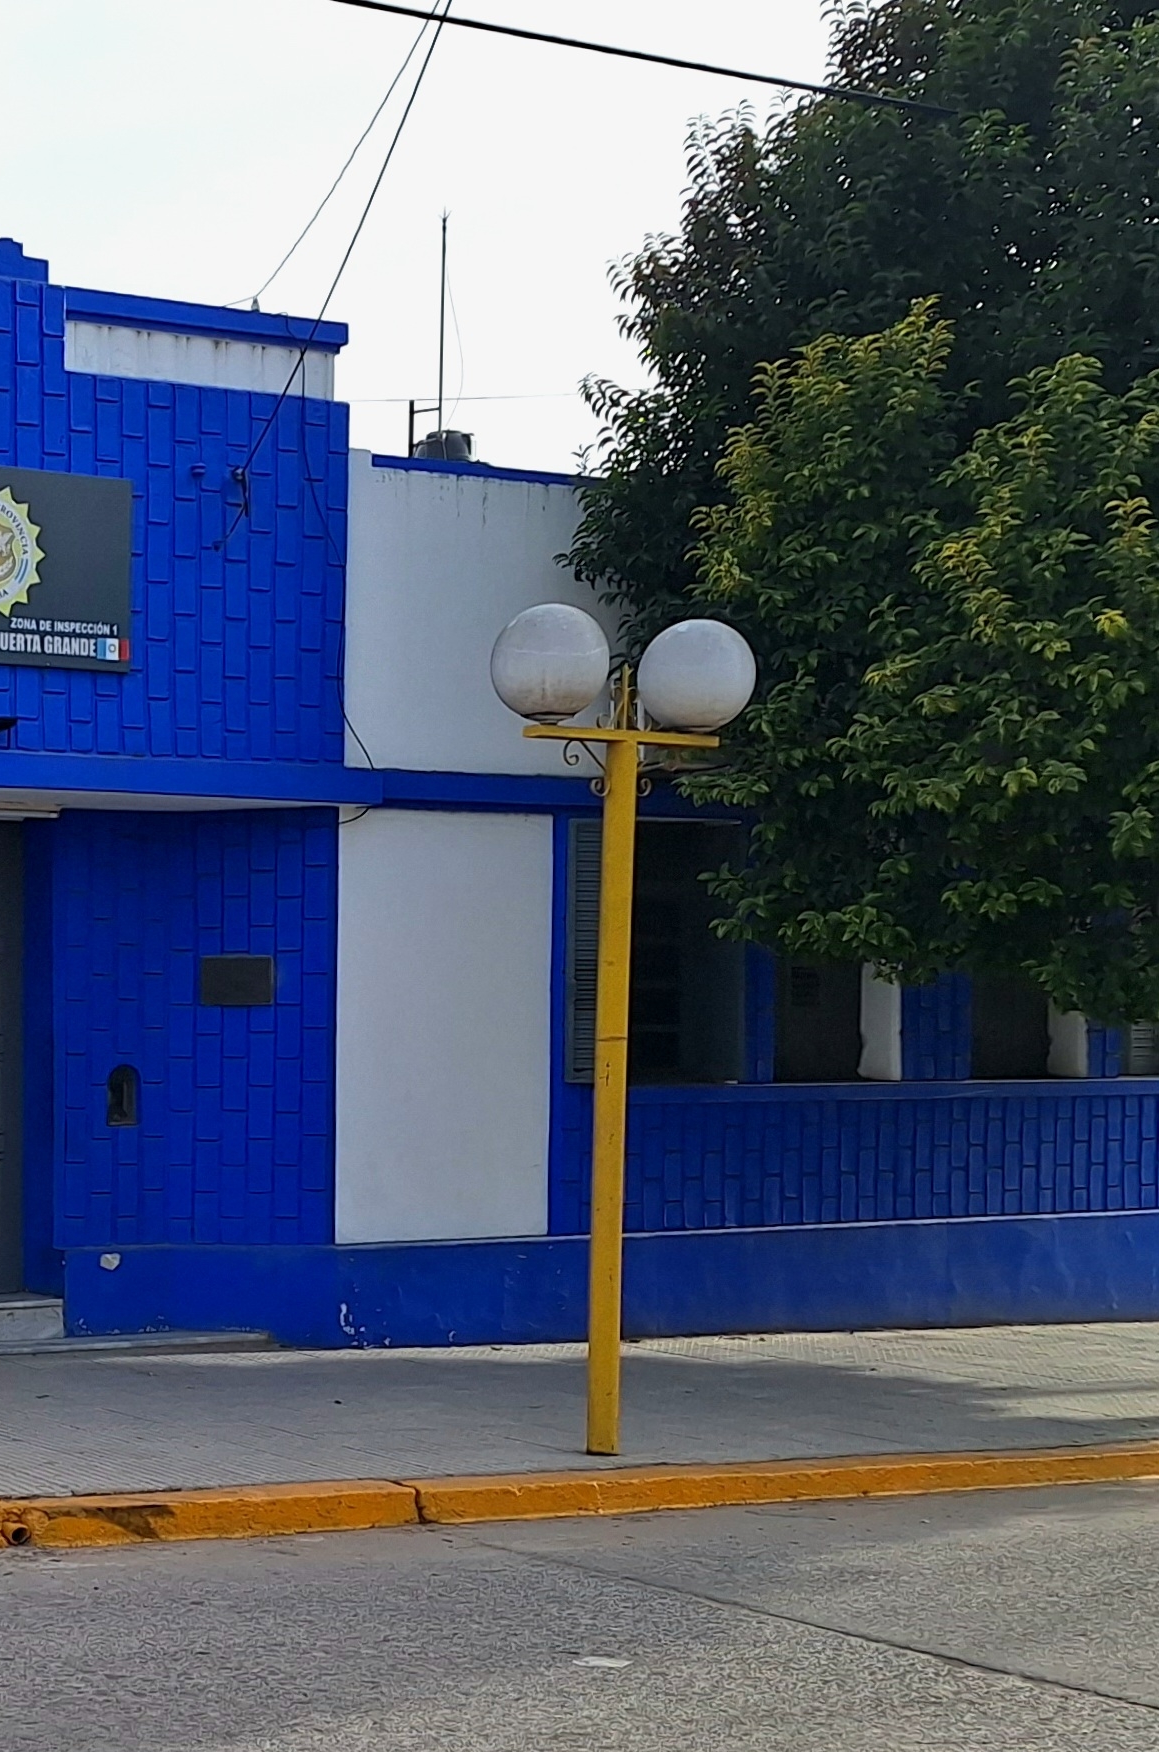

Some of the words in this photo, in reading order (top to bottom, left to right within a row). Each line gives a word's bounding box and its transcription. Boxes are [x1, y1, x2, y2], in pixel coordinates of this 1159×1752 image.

[10, 617, 38, 631] ZONA
[39, 620, 53, 632] DE
[53, 620, 111, 636] INSPECCIÓN
[112, 624, 119, 636] 1
[43, 635, 96, 657] GRANDE
